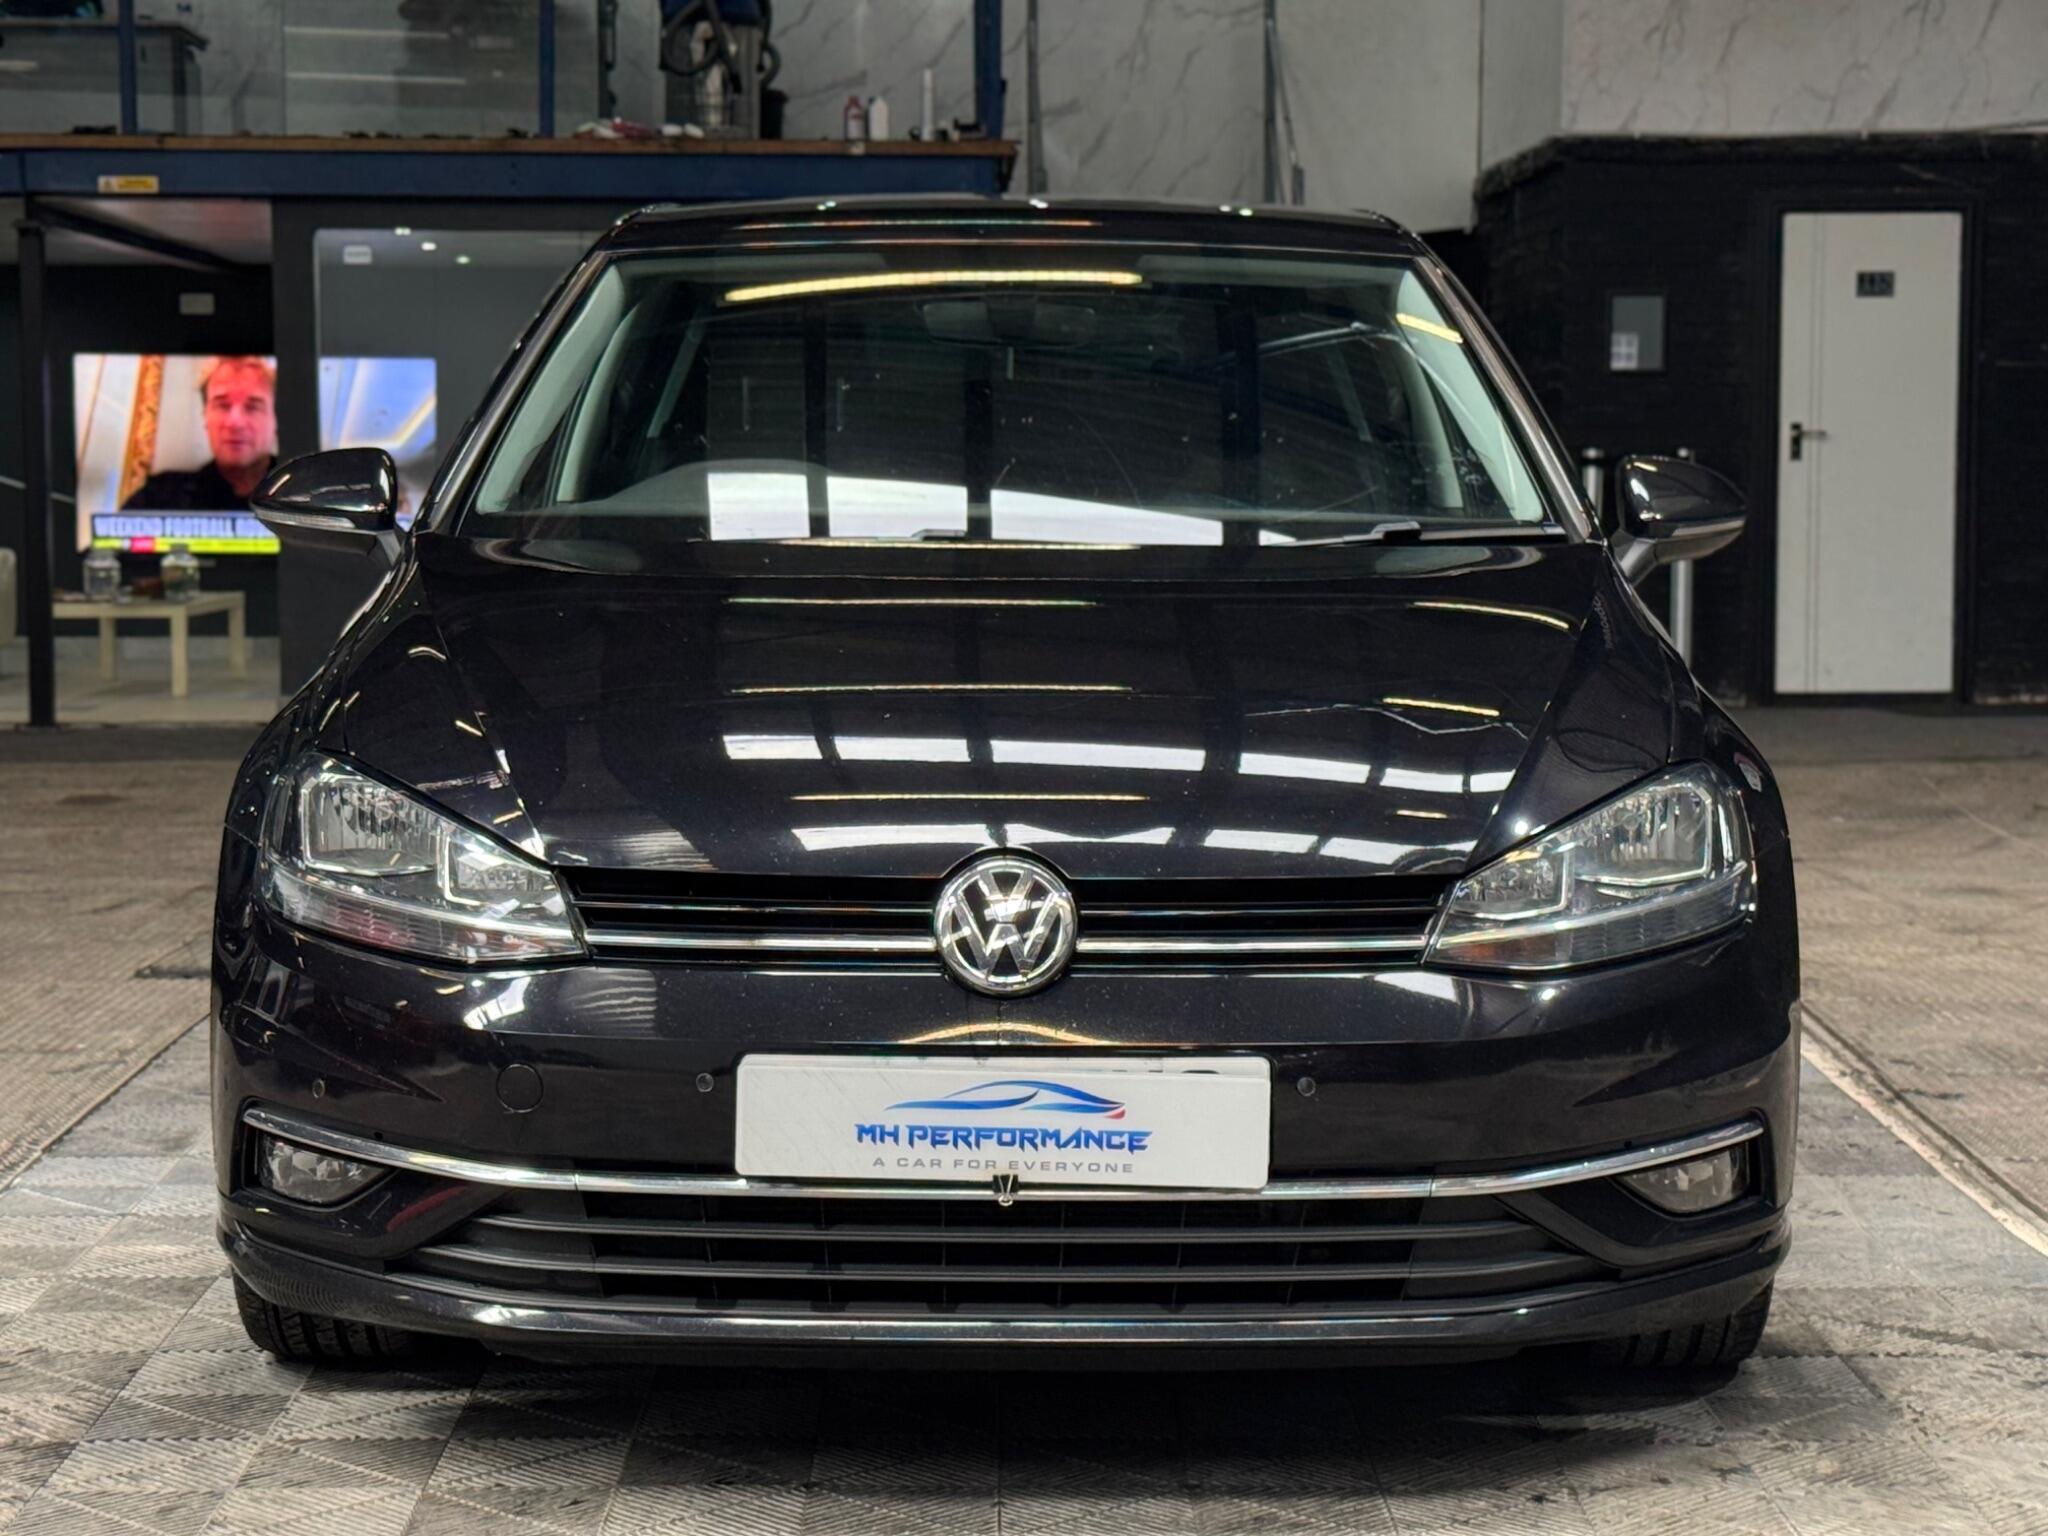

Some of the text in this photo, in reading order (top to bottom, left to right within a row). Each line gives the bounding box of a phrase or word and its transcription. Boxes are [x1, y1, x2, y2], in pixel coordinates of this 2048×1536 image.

[854, 1123, 1153, 1155] MH PERFORMANCE
[872, 1157, 1134, 1173] A CAR FOR EVERYONE
